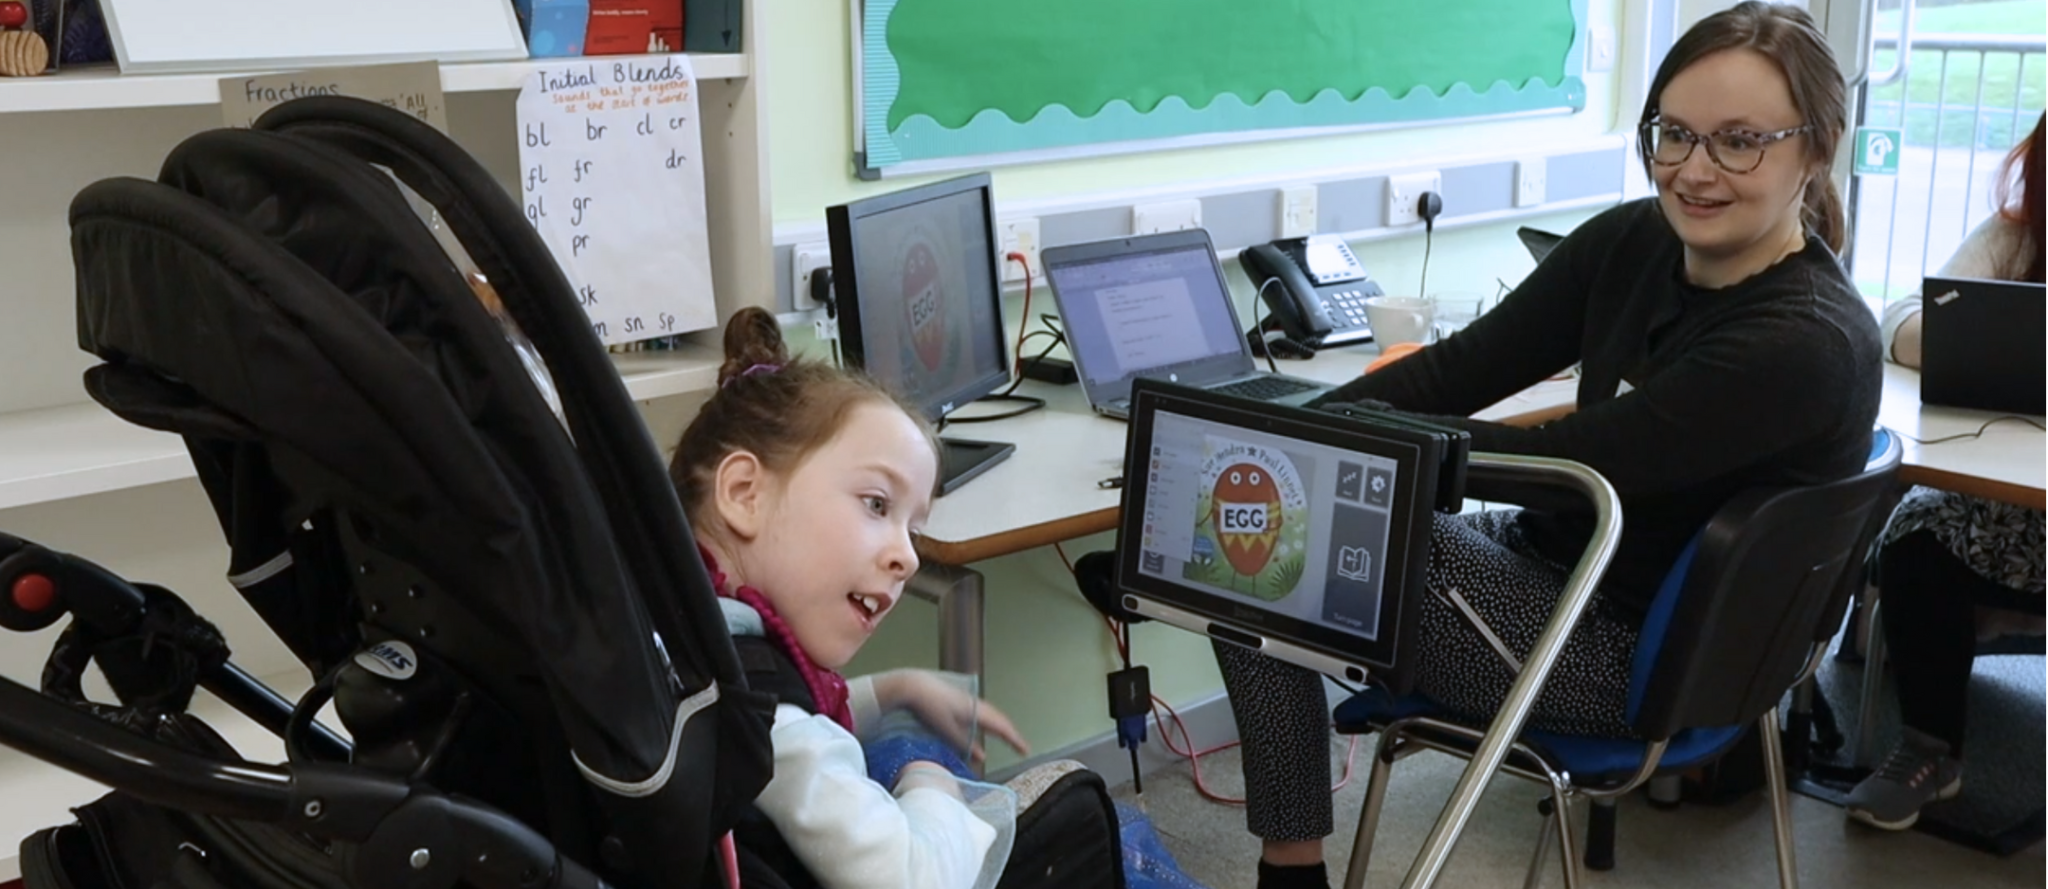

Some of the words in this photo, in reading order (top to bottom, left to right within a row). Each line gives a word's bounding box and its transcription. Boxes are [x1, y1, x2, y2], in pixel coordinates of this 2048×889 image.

[539, 65, 596, 93] Initial
[614, 57, 684, 83] Blends
[245, 79, 338, 103] Fractions
[600, 86, 623, 98] that
[526, 121, 551, 148] bl
[586, 117, 607, 141] br
[637, 113, 653, 136] cl
[669, 115, 686, 130] cr
[525, 164, 548, 192] fl
[574, 159, 593, 183] fr
[665, 149, 687, 169] dr
[571, 197, 592, 227] gr
[571, 234, 590, 257] pr
[580, 284, 598, 306] sk
[911, 290, 935, 327] EGG
[624, 316, 645, 333] sn
[1224, 509, 1264, 528] EGG
